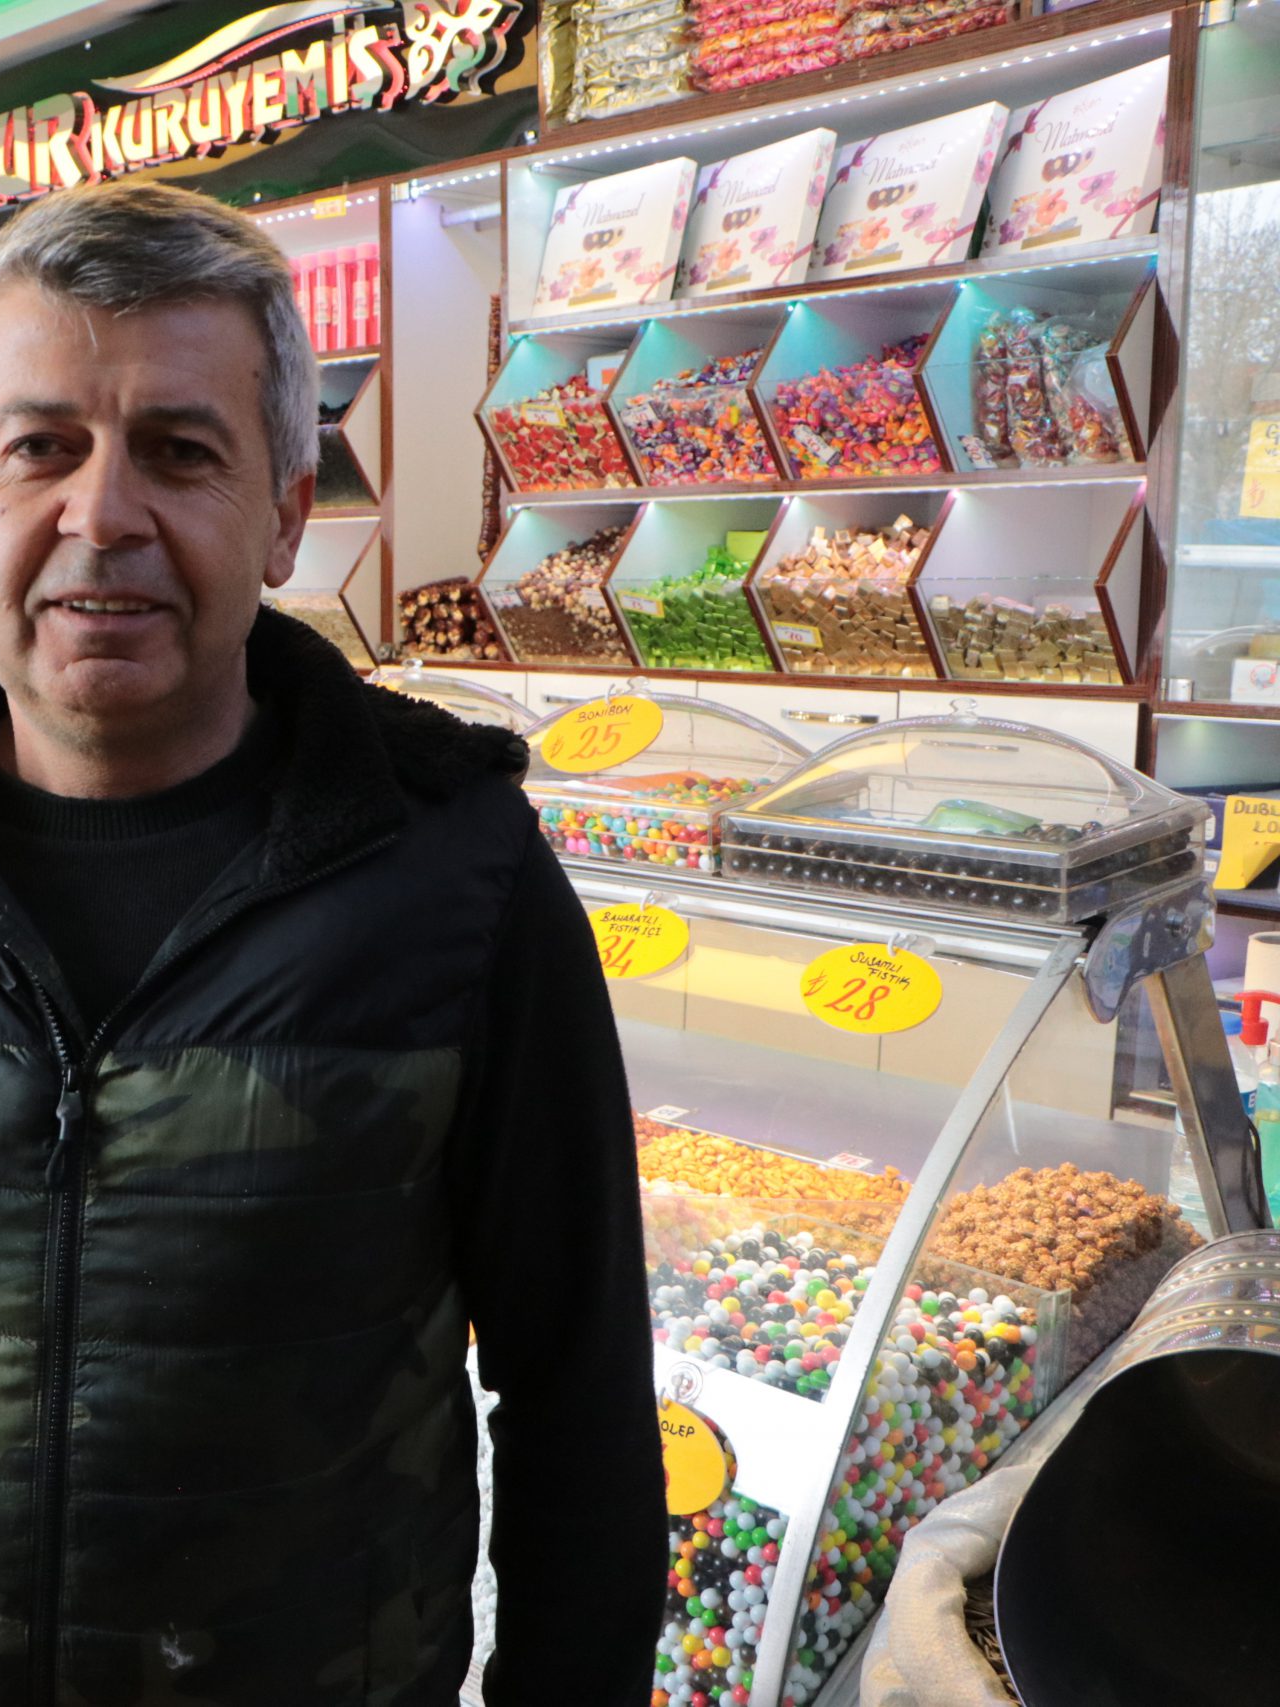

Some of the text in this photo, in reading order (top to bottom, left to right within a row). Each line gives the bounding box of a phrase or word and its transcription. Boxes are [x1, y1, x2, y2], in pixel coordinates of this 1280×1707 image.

[567, 721, 631, 761] 25
[600, 935, 636, 977] 34
[824, 977, 891, 1021] 28
[868, 967, 912, 991] FISTIK
